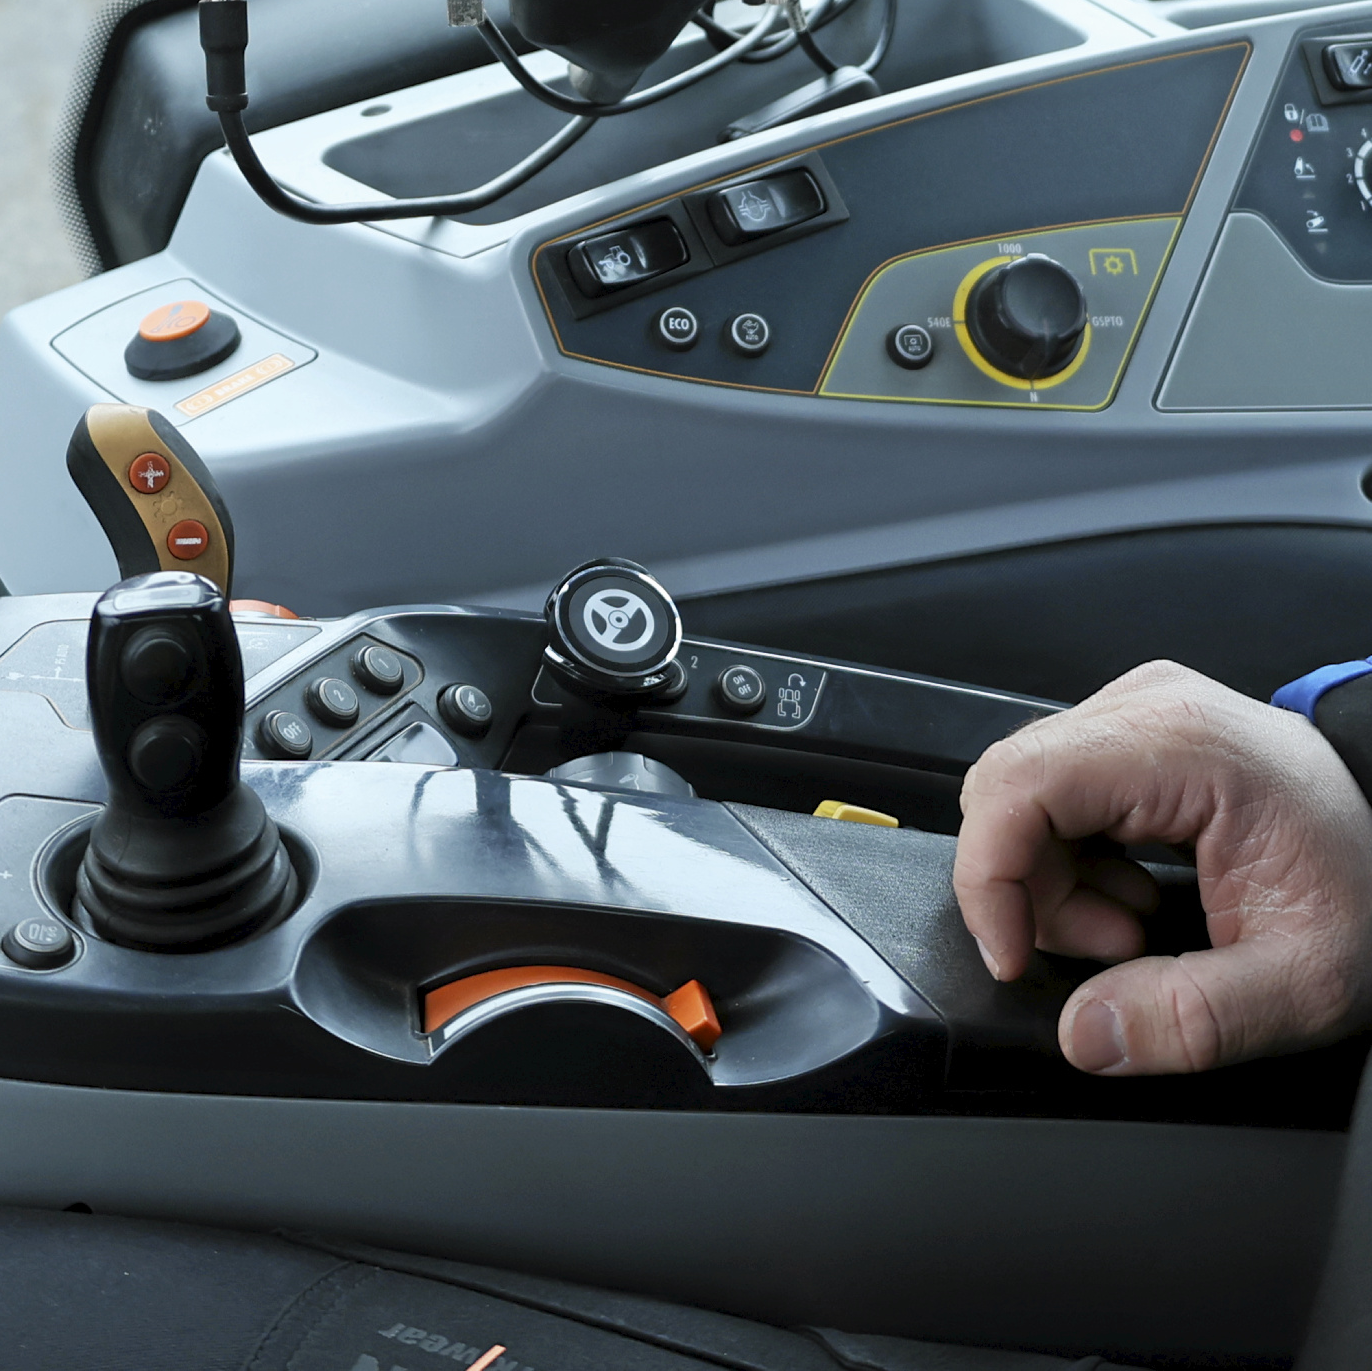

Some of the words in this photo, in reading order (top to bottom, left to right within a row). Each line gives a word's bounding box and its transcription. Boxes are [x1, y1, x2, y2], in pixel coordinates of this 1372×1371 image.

[1345, 147, 1354, 158] 3
[1345, 173, 1354, 184] 2
[997, 243, 1022, 254] 1000
[668, 317, 690, 330] ECO
[927, 317, 952, 328] 540E
[1091, 316, 1123, 327] GSPTO
[1030, 391, 1038, 403] N
[690, 655, 699, 669] 2
[732, 674, 746, 685] ON
[738, 683, 752, 696] OFF
[332, 688, 345, 703] 2
[282, 720, 303, 740] OFF
